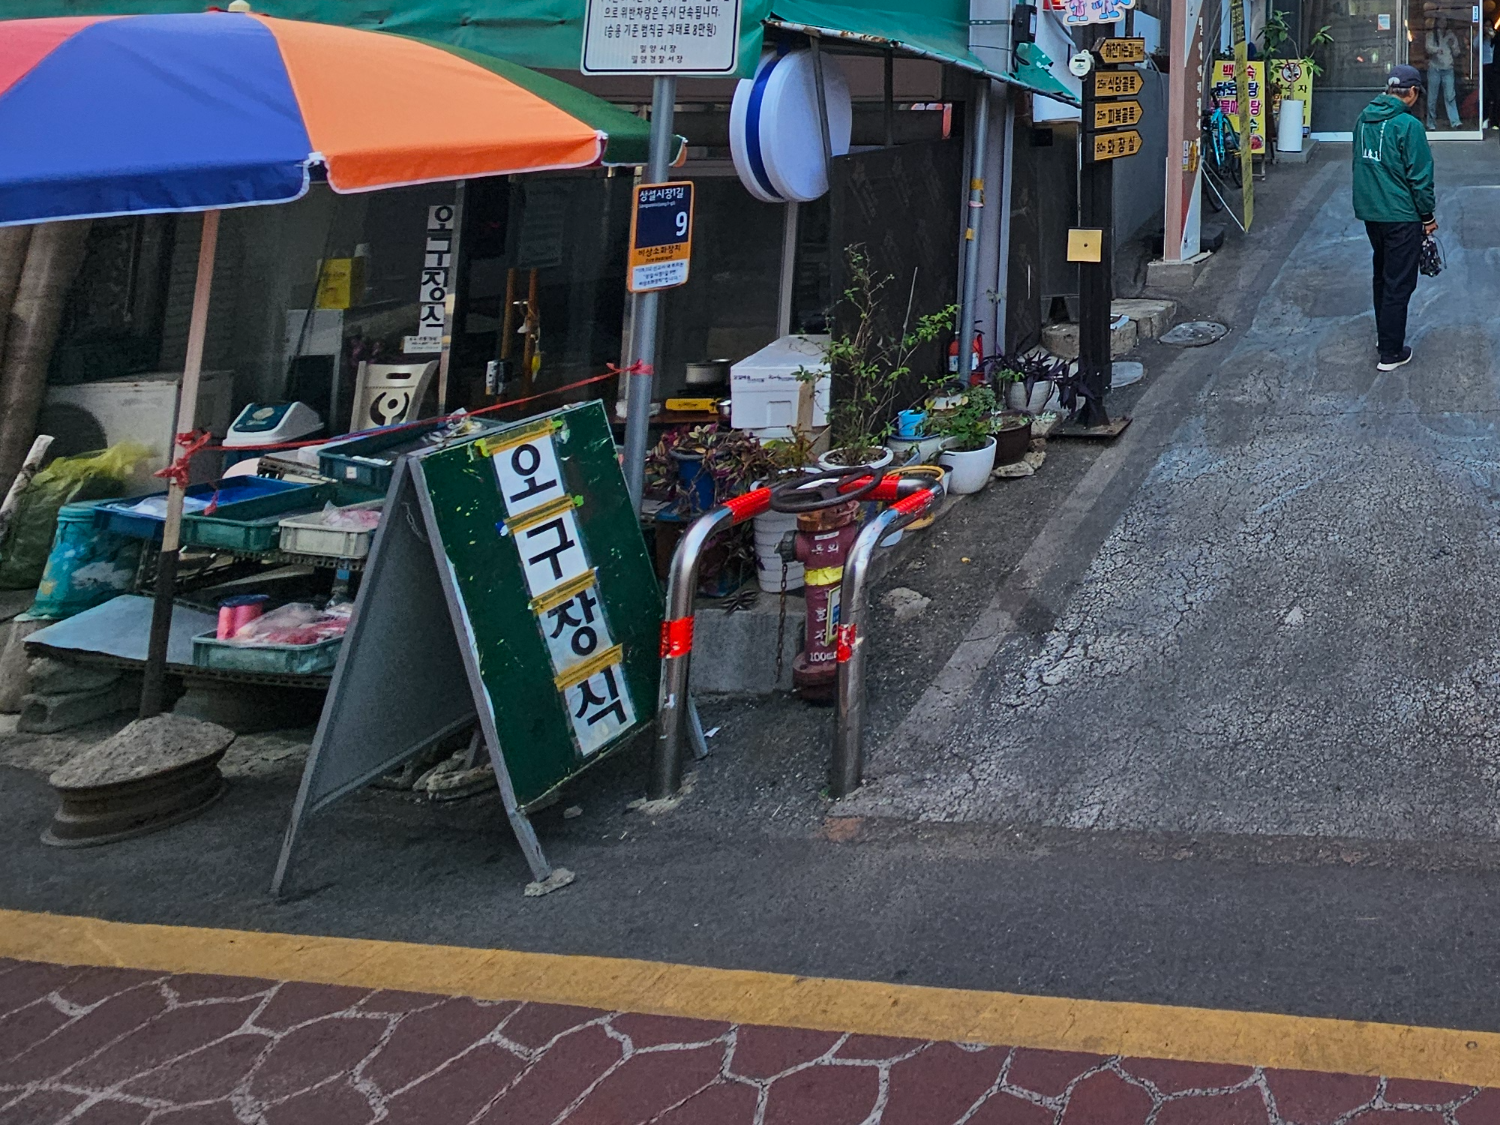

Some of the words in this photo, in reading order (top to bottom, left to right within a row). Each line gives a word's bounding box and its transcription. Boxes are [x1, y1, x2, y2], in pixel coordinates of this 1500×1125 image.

[603, 6, 619, 18] 으로
[620, 6, 660, 20] 위반차량은
[661, 6, 677, 19] 즉시
[624, 24, 639, 38] 기준
[1107, 76, 1136, 93] 식당골목
[1107, 135, 1136, 155] 화장실
[675, 211, 688, 237] 9
[508, 442, 630, 728] 오구장식
